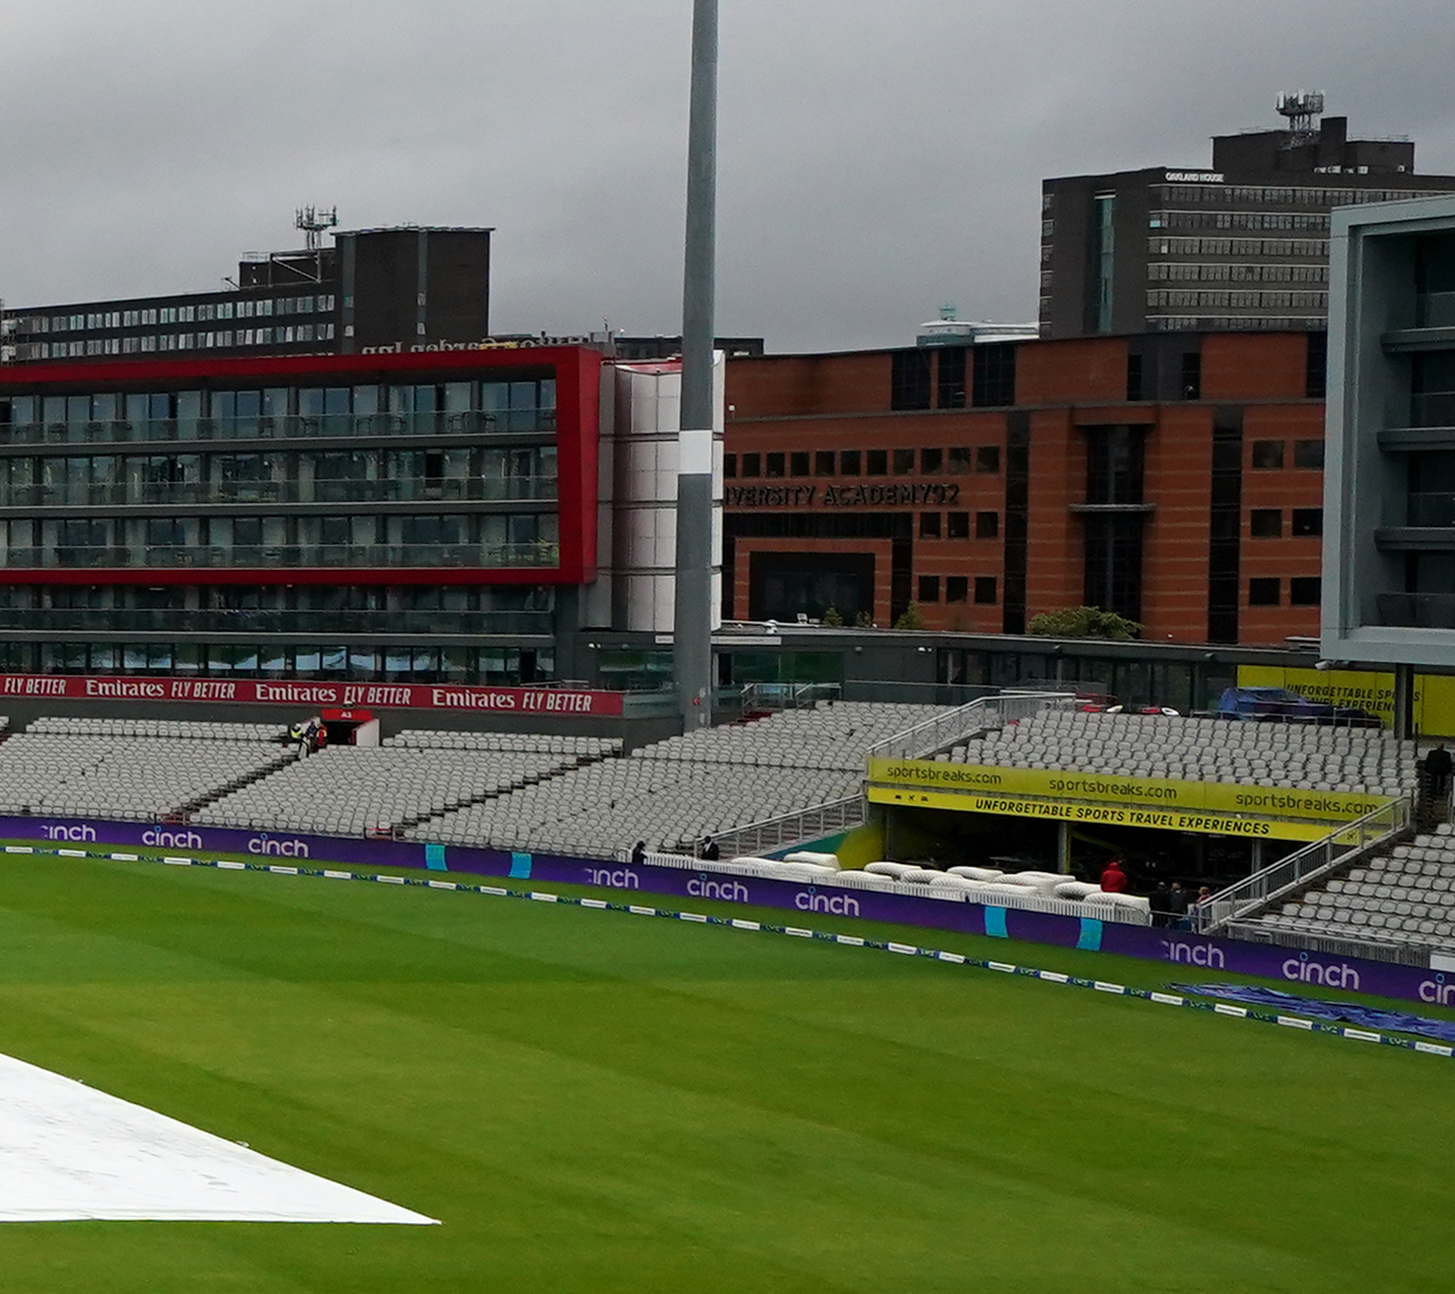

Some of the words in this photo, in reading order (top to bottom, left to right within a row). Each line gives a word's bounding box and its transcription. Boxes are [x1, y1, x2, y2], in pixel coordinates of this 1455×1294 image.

[4, 678, 23, 693] FLY
[26, 678, 66, 694] BETTER
[86, 680, 164, 698] Emirates
[170, 681, 191, 699] FLY
[193, 682, 235, 699] BETTER
[255, 684, 336, 703] Emirates
[343, 686, 364, 704] FLY
[368, 687, 411, 705] BETTER
[1287, 684, 1372, 699] UNFORGETTABLE
[433, 689, 515, 709] Emirates
[523, 692, 543, 710] FLY
[546, 693, 592, 712] BETTER
[887, 766, 1001, 785] sportsbreaks.com
[1049, 778, 1177, 799] sportsbreaks.com
[1236, 793, 1377, 815] sportsbreaks.com
[975, 799, 1071, 817] UNFORGETTABLE
[1076, 808, 1124, 822] SPORTS
[1130, 812, 1173, 827] TRAVEL
[1179, 817, 1270, 835] EXPERIENCES
[142, 826, 202, 850] cinch
[248, 833, 309, 858] cinch
[687, 873, 749, 903] cinch
[794, 887, 860, 917] cinch
[1281, 952, 1360, 991] cinch
